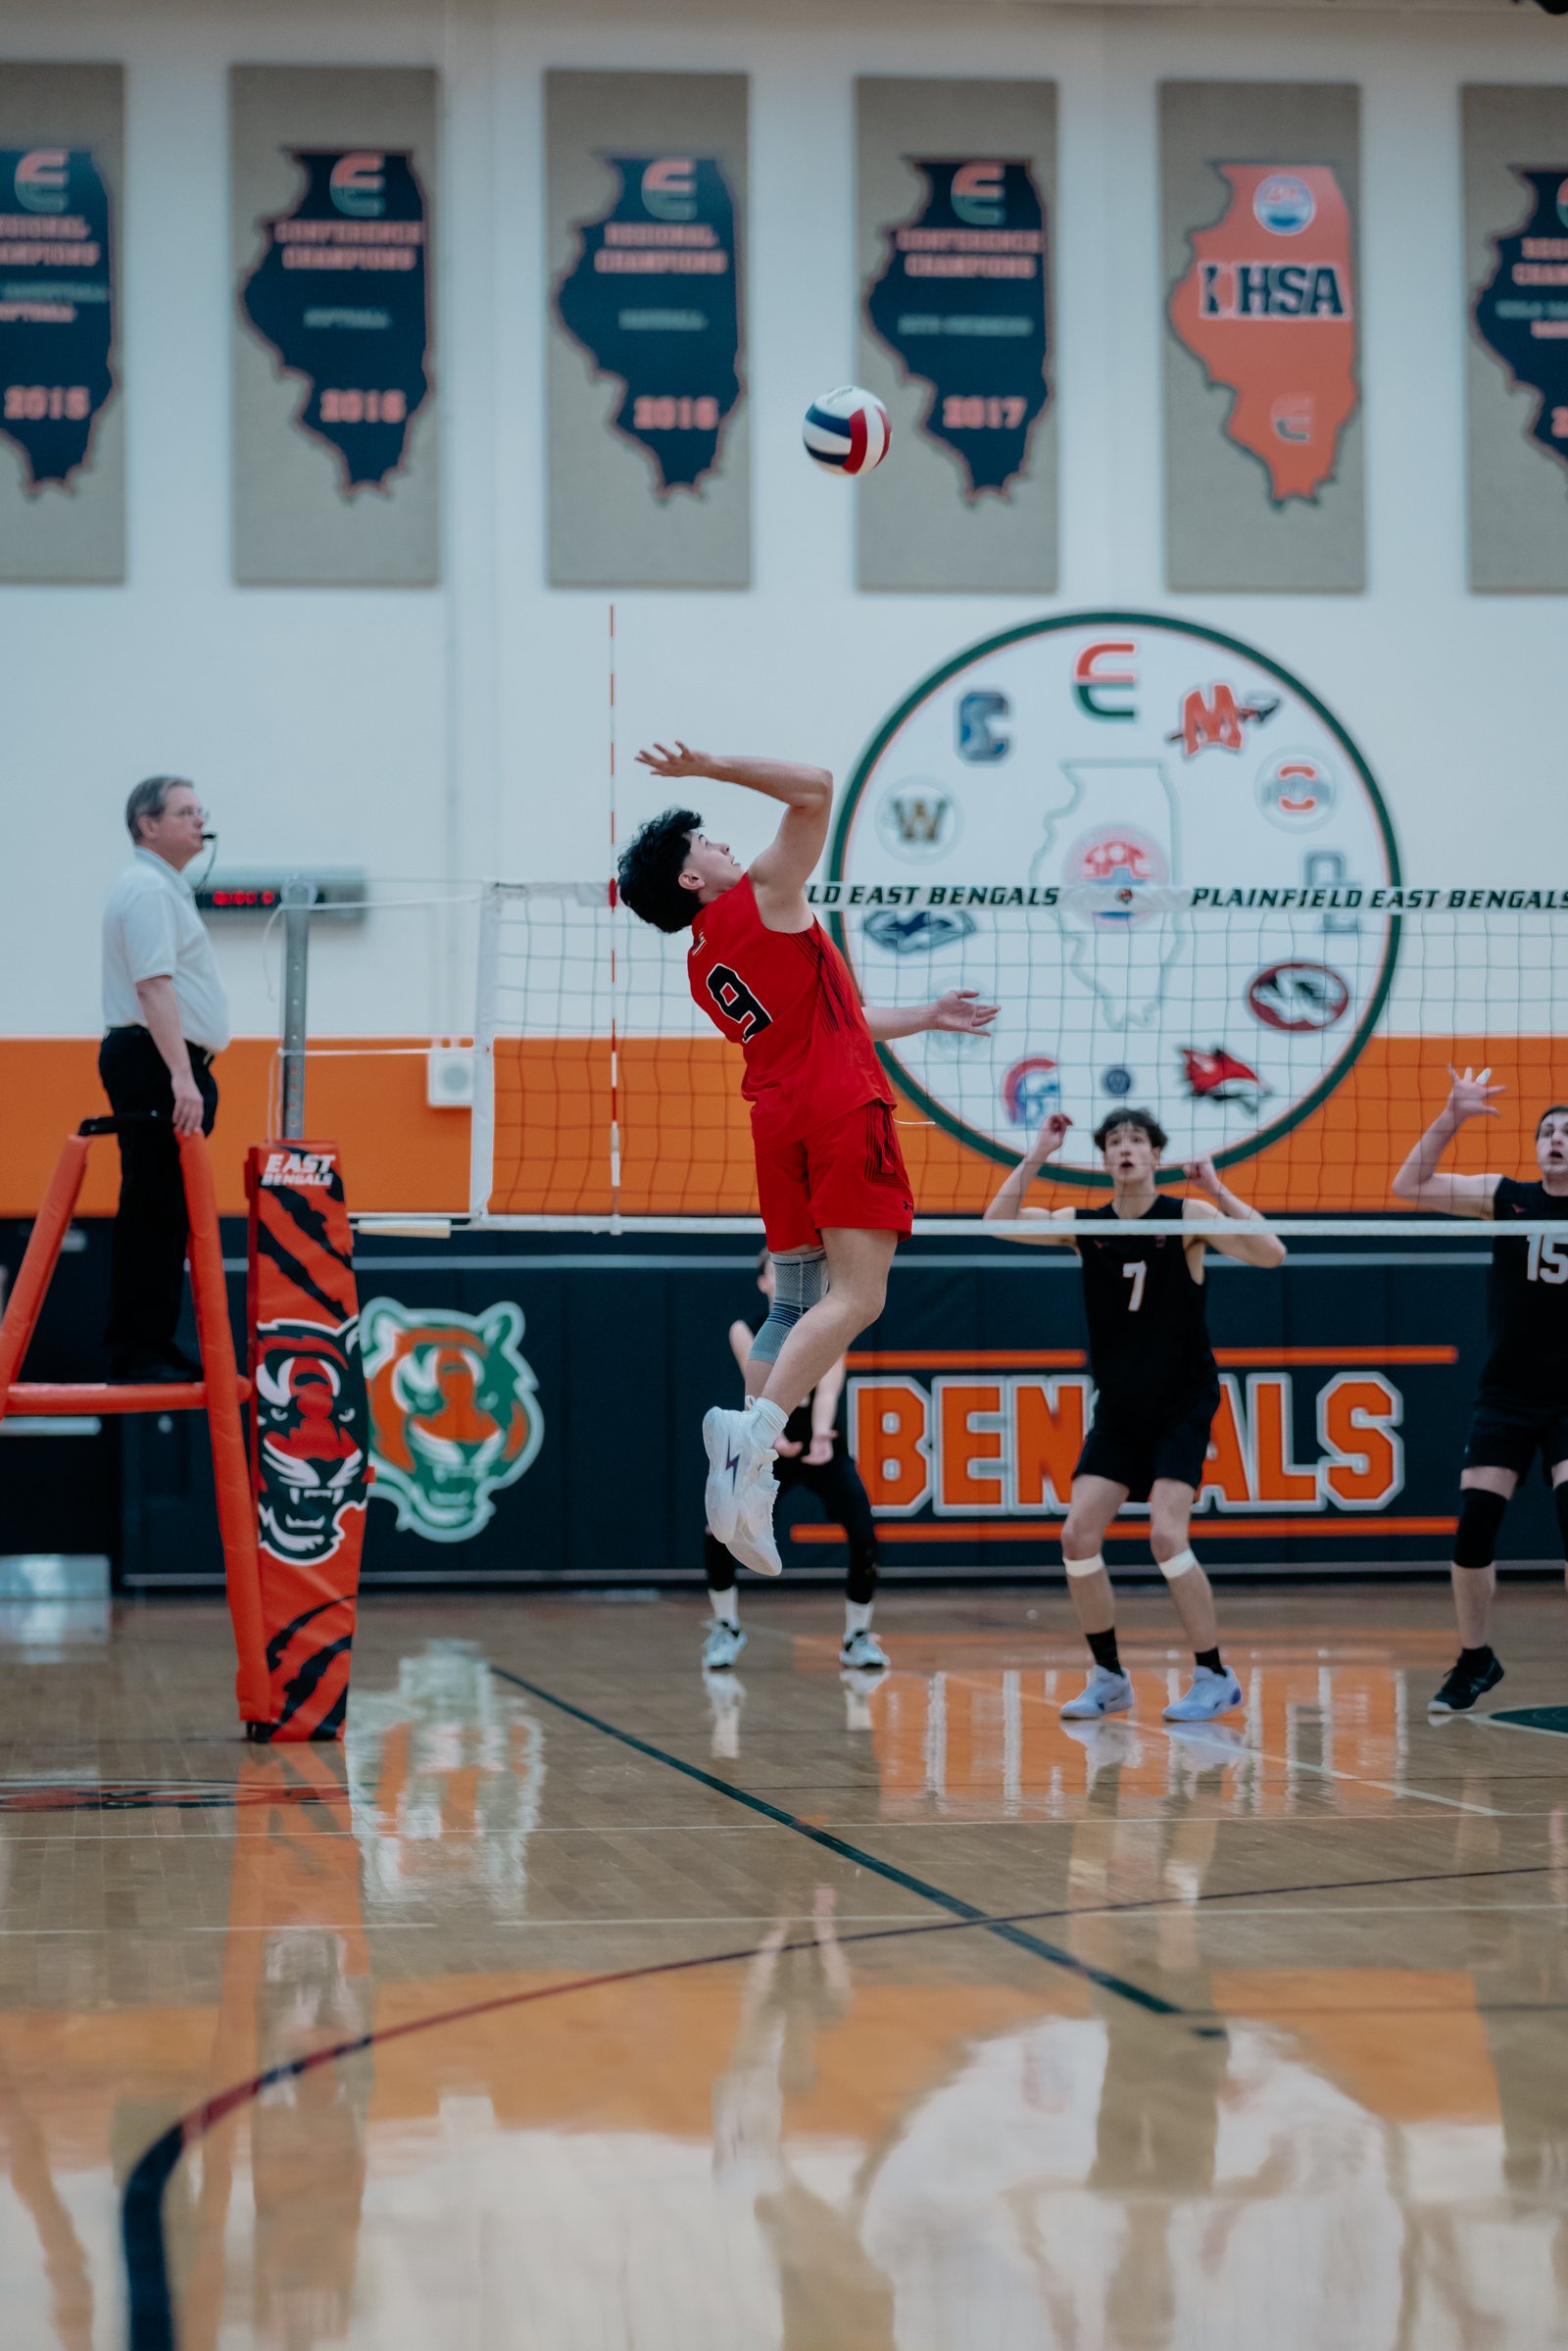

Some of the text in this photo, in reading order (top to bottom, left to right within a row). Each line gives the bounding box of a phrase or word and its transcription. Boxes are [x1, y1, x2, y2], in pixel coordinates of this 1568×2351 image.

[942, 396, 1026, 429] 2017
[892, 799, 947, 845] W
[848, 886, 921, 906] EAST
[926, 886, 1060, 906] BENGALS
[1191, 887, 1362, 909] PLAINFIELD
[1371, 889, 1441, 909] EAST
[706, 962, 773, 1044] 9
[266, 1153, 337, 1174] EAST
[1526, 1231, 1568, 1285] 15
[1122, 1259, 1147, 1312] 7
[848, 1372, 1404, 1517] BENALS
